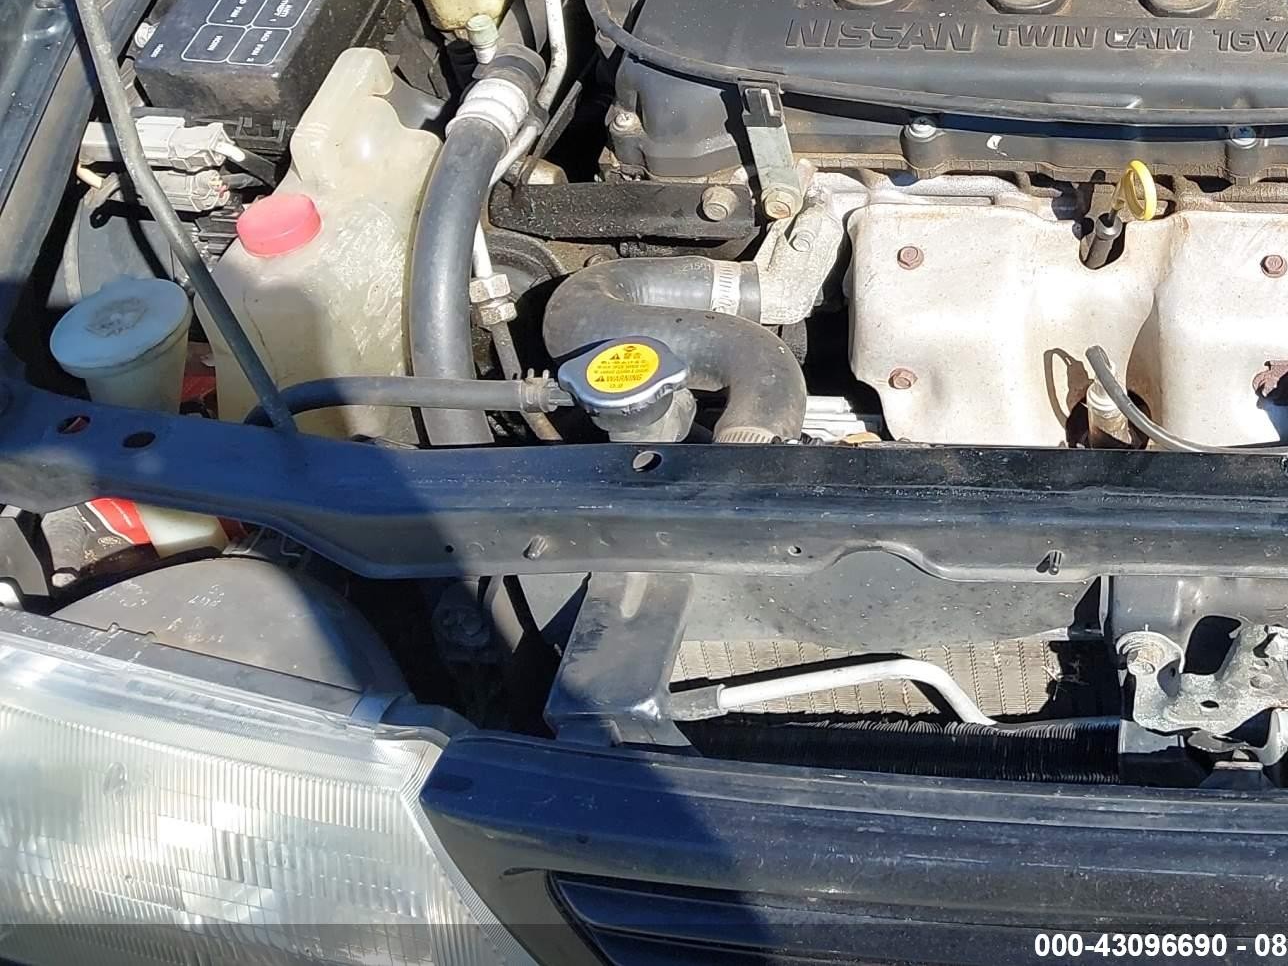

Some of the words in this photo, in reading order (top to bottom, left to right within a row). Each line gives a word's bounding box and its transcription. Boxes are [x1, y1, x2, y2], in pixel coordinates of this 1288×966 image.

[784, 18, 977, 52] NISSAN
[994, 24, 1095, 49] TWIN
[1104, 24, 1191, 51] CAM
